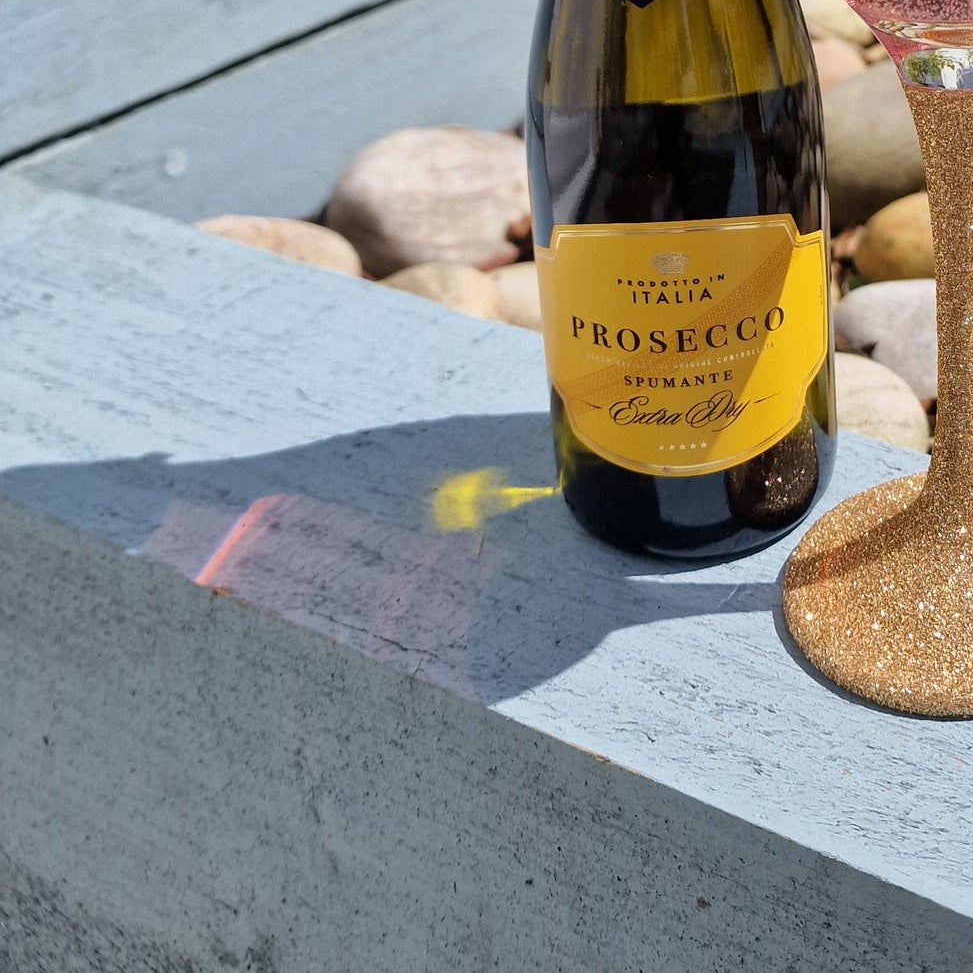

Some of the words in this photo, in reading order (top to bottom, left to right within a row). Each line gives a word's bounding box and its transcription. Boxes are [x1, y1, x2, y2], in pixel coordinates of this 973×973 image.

[617, 278, 700, 288] PRODOTTO
[709, 273, 725, 282] IN
[632, 287, 713, 305] ITALIA
[570, 306, 785, 354] PROSECCO
[624, 369, 733, 389] SPUMANTE
[608, 396, 683, 426] Extra
[685, 389, 753, 433] Dry
